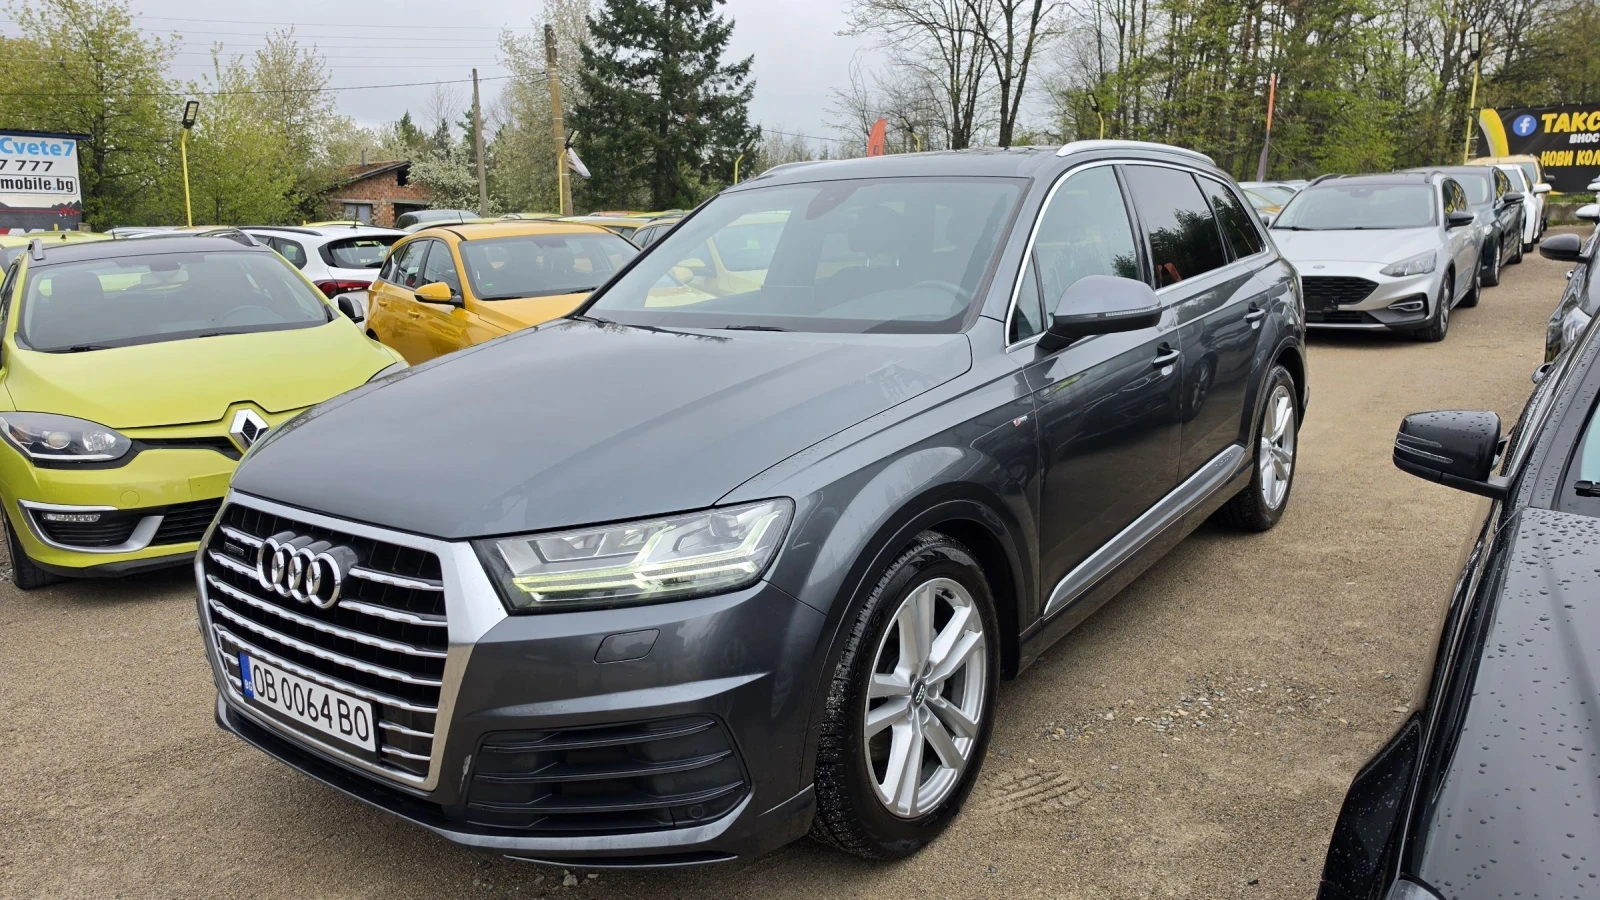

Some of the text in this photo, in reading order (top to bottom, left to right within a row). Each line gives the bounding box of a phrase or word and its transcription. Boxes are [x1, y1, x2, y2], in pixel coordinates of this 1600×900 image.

[0, 137, 74, 156] Cvete7
[1540, 150, 1574, 166] НОВИ
[15, 160, 54, 172] 777
[0, 177, 73, 192] mobile.bg
